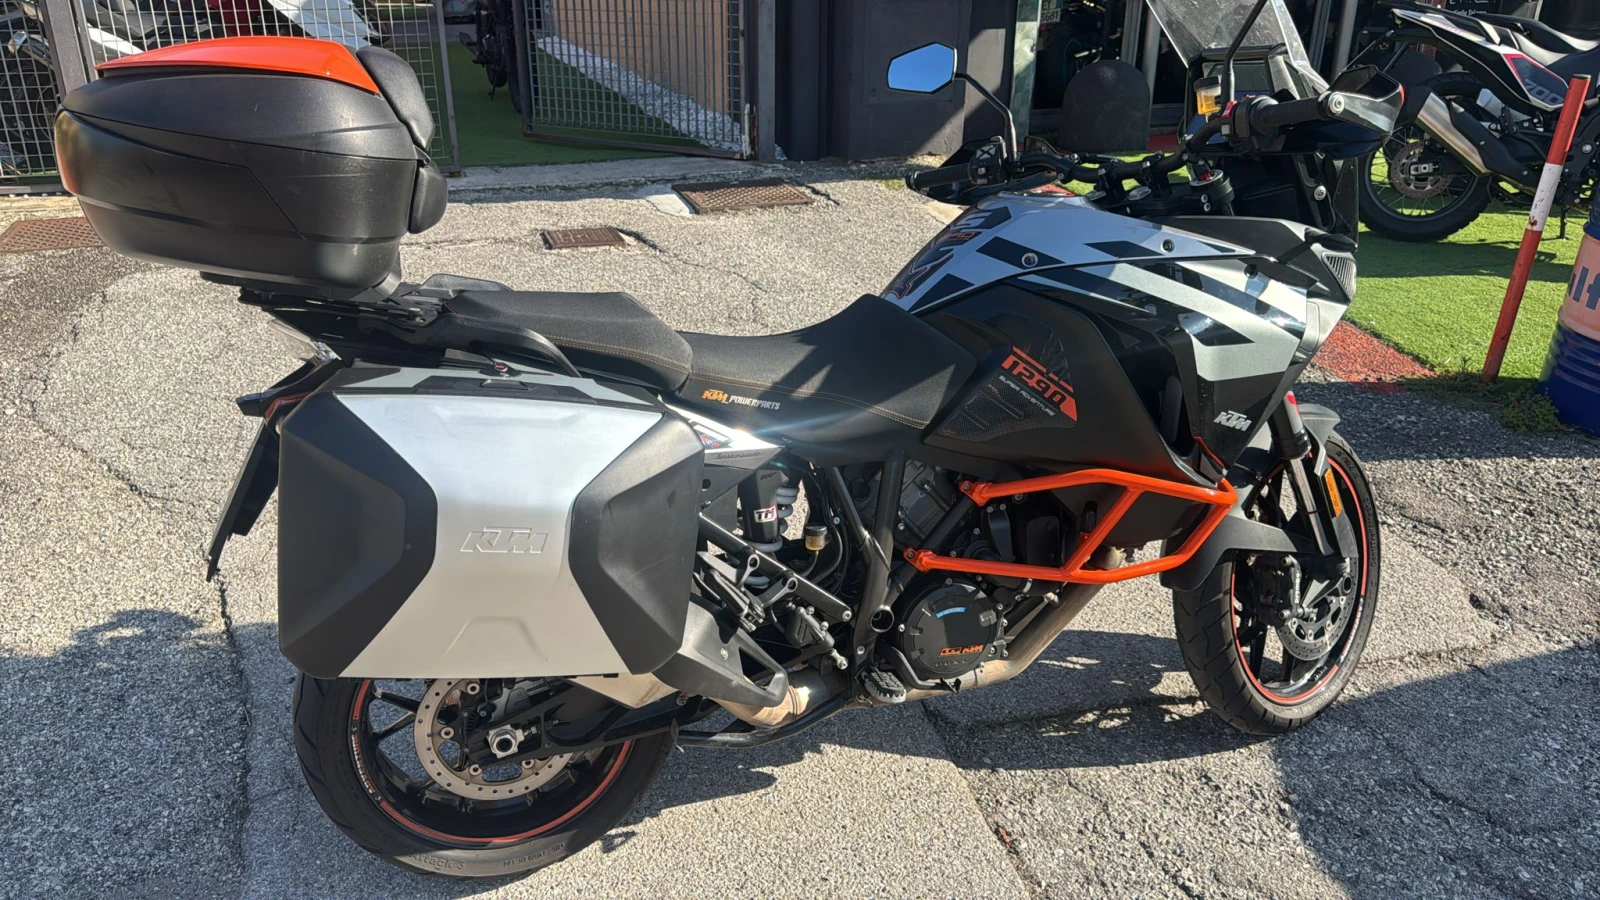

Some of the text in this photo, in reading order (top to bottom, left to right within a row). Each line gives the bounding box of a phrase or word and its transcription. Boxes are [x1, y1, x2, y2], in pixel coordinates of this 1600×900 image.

[702, 389, 780, 410] KTM POWERPARTS
[999, 375, 1056, 417] SUPER ADVENTURE
[1213, 410, 1252, 431] KTM
[460, 526, 548, 554] KTM
